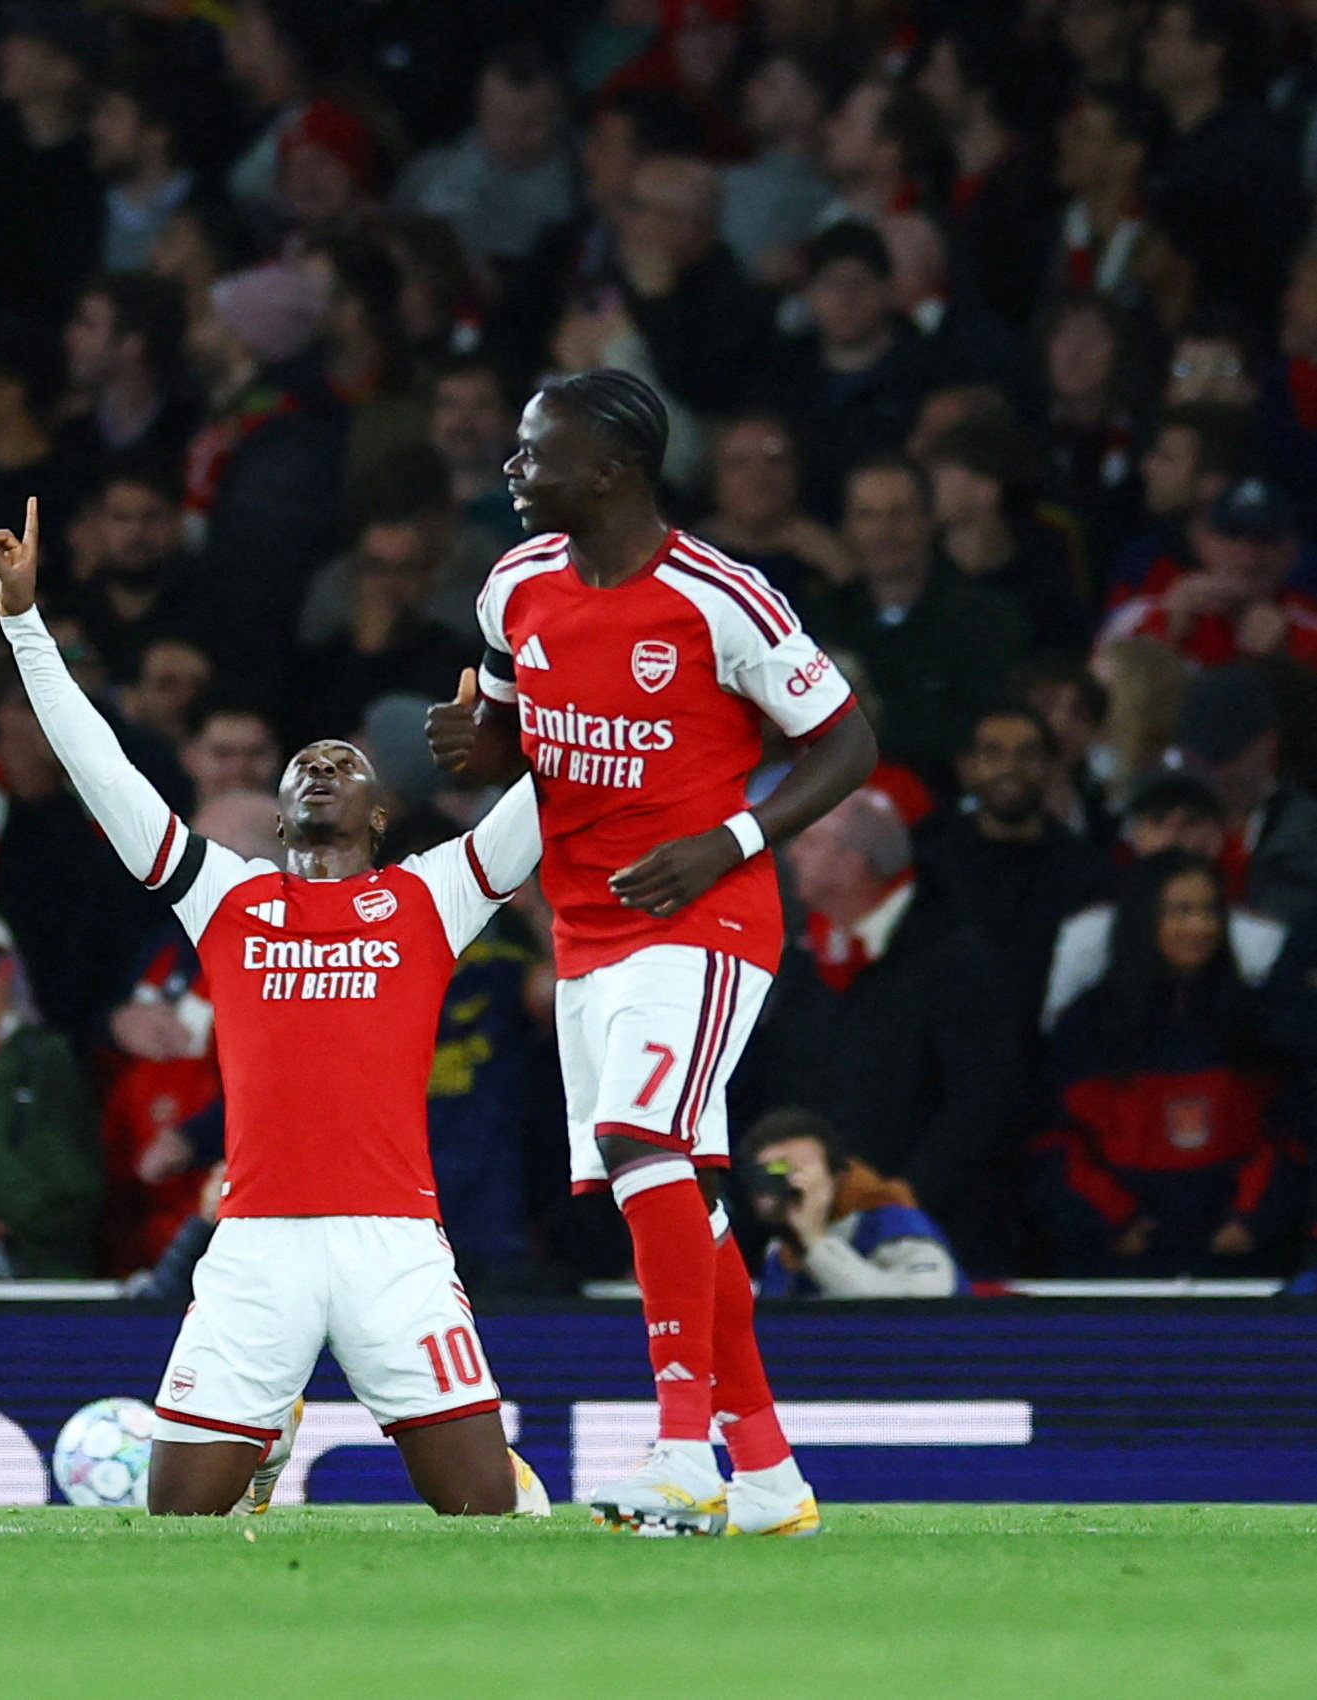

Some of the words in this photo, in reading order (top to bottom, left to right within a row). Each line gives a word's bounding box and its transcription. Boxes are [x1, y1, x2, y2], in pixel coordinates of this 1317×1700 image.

[517, 692, 674, 751] Emirates
[537, 742, 564, 779] FLY
[568, 749, 645, 789] BETTER
[243, 936, 401, 970] Emirates
[262, 972, 298, 1001] FLY
[300, 971, 378, 1000] BETTER
[630, 1041, 677, 1110] 7
[648, 1320, 681, 1338] AFC
[417, 1324, 483, 1396] 10
